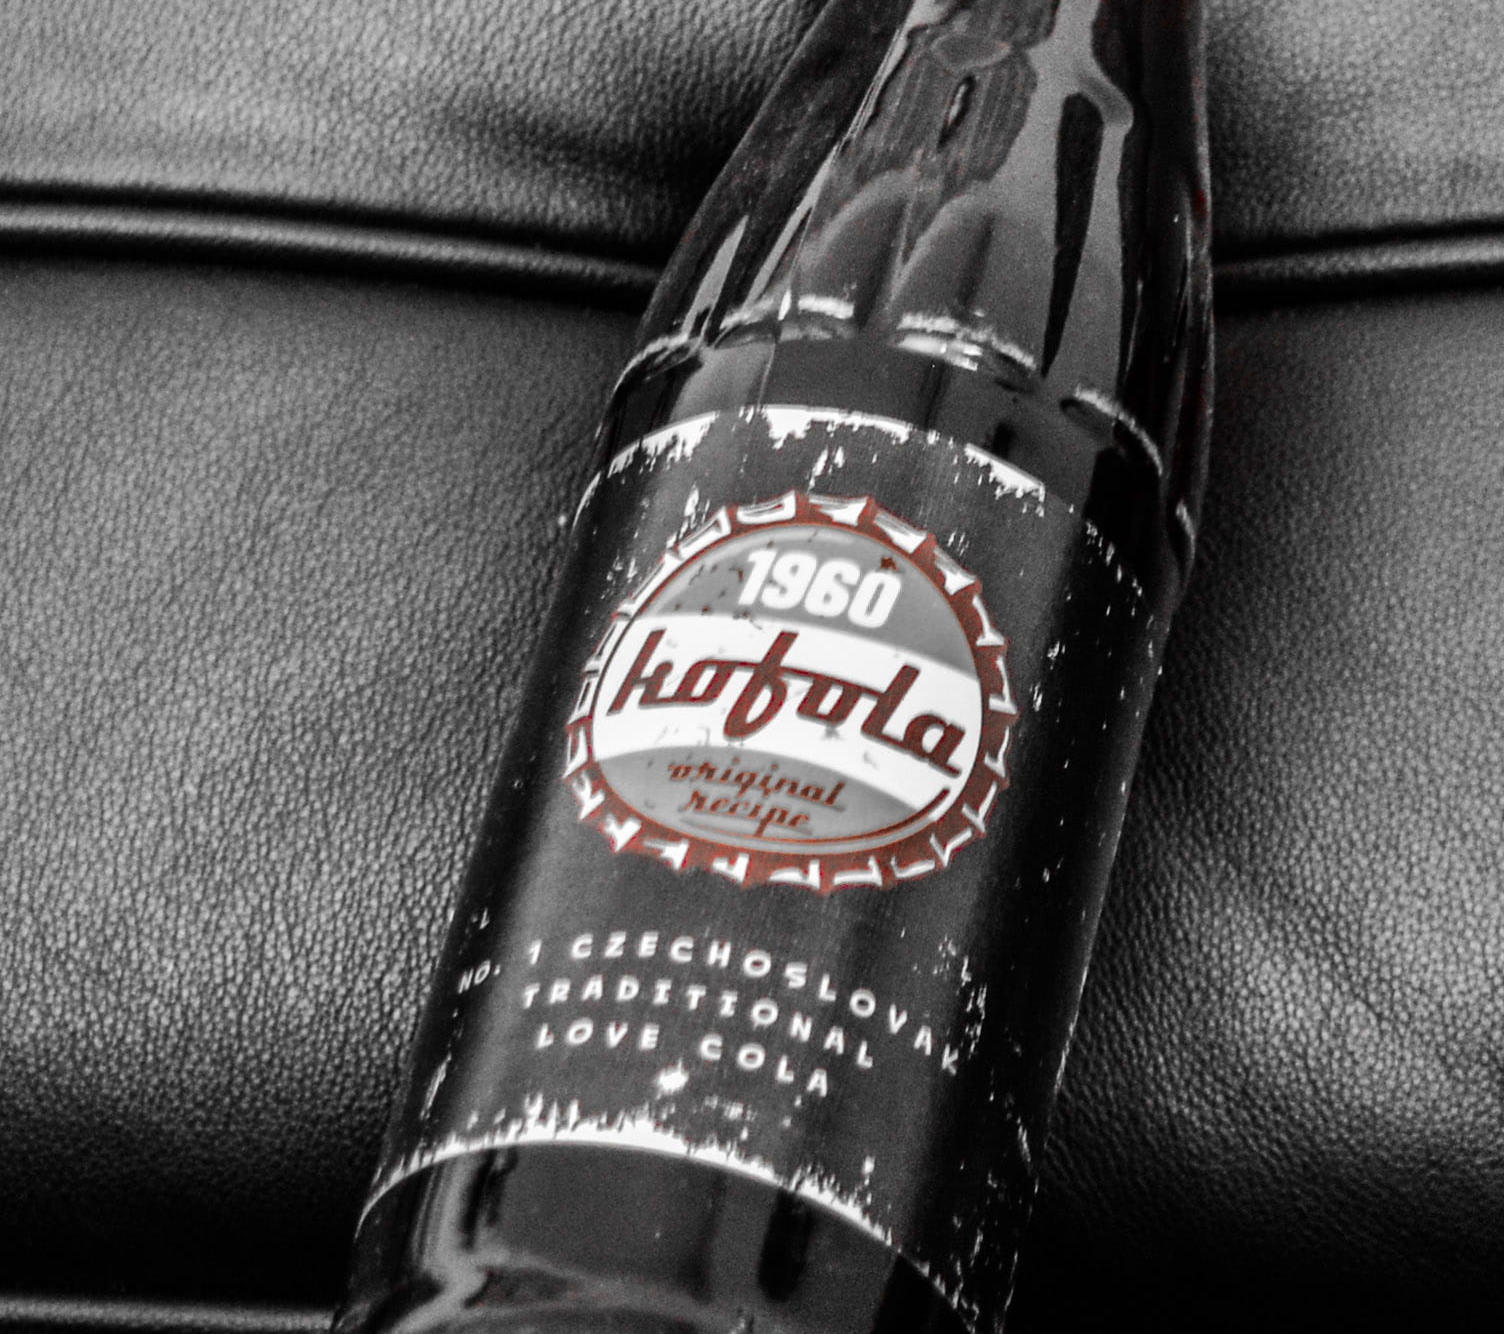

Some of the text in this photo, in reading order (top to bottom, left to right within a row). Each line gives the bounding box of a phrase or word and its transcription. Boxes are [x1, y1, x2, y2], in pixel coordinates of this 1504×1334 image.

[738, 548, 902, 629] 1960
[606, 628, 966, 779] kofola
[668, 757, 846, 813] original
[681, 789, 813, 840] recipe
[457, 929, 960, 1077] NO. 1 CZECHOSLOVAK
[522, 973, 874, 1069] TRADITIONAL
[536, 1017, 830, 1098] LOVE COLA
